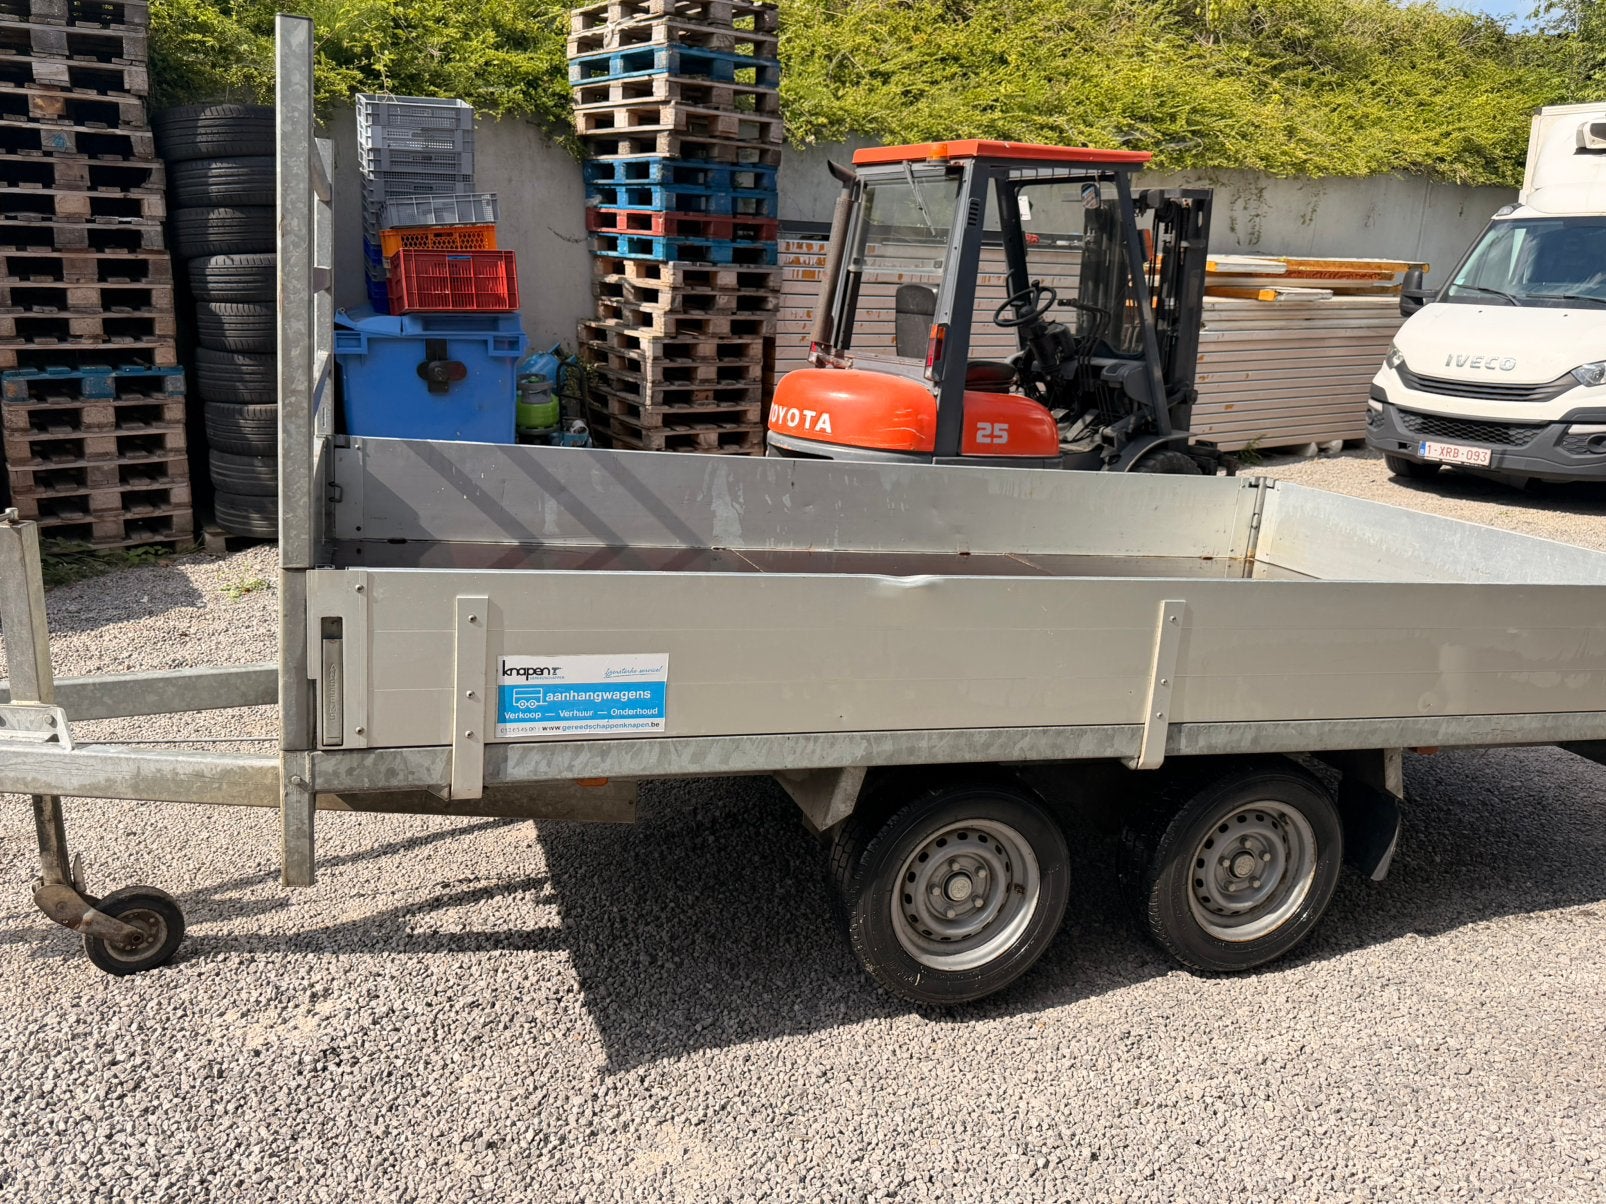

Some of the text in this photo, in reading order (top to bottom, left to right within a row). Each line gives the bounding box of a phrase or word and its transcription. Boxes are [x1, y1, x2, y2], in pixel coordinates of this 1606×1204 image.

[1445, 353, 1517, 371] IVECO
[770, 403, 832, 433] OYOTA
[976, 421, 1009, 444] 25
[1427, 444, 1488, 462] 1-XRB-093
[502, 659, 551, 681] knapen
[546, 690, 651, 702] aanhangwagens
[505, 707, 658, 720] Verkoop Verhuur Onderhoud
